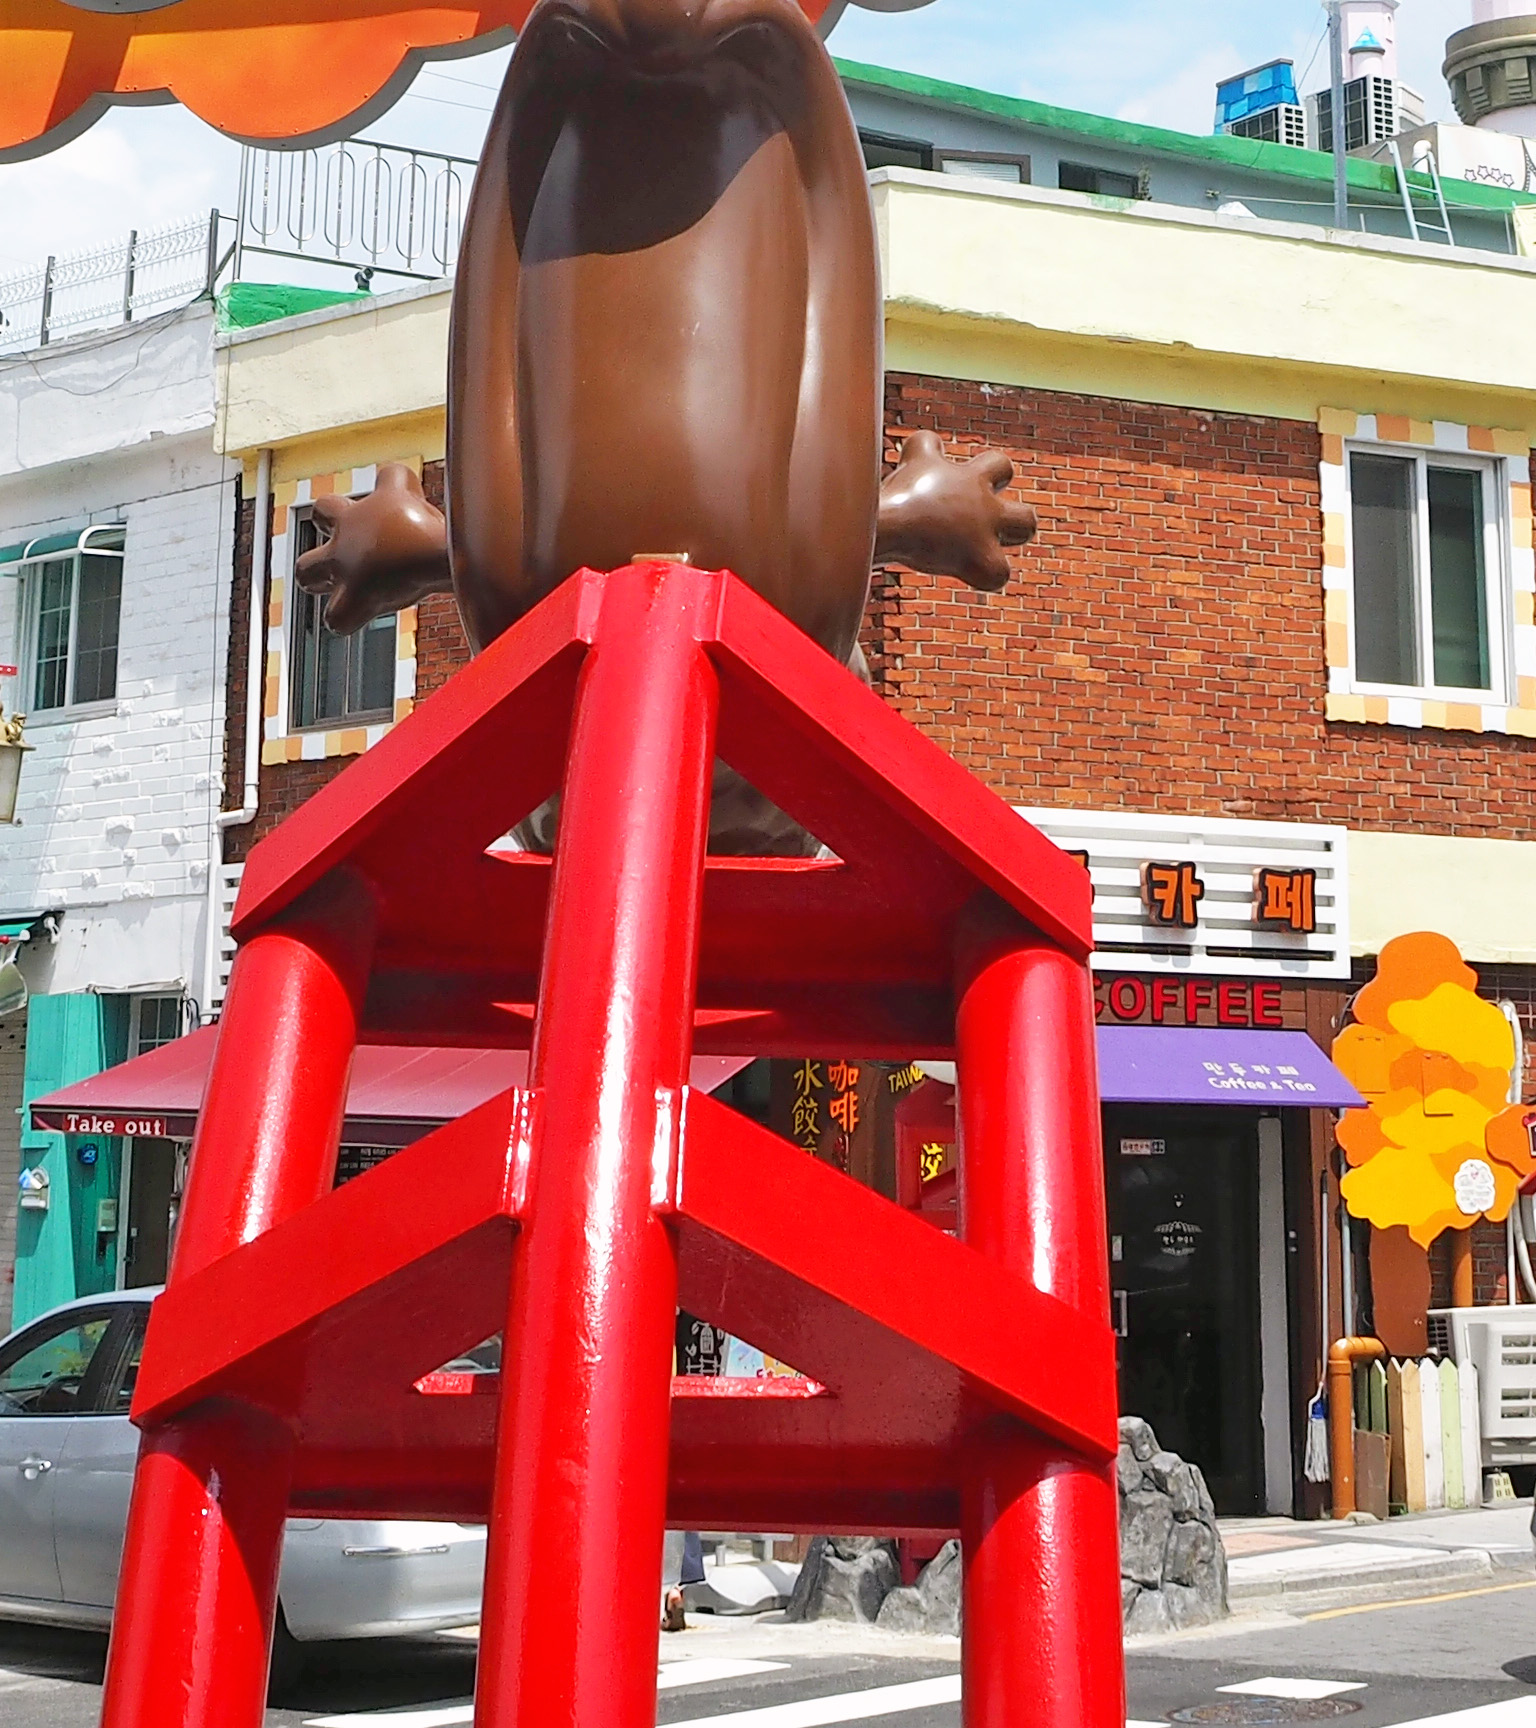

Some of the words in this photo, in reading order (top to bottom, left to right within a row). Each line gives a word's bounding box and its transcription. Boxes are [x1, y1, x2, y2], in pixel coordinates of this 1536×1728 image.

[1207, 1077, 1267, 1090] Coffee
[1281, 1079, 1317, 1092] Tea
[827, 1059, 860, 1134] 咖啡
[67, 1113, 115, 1134] Take
[124, 1119, 162, 1136] out
